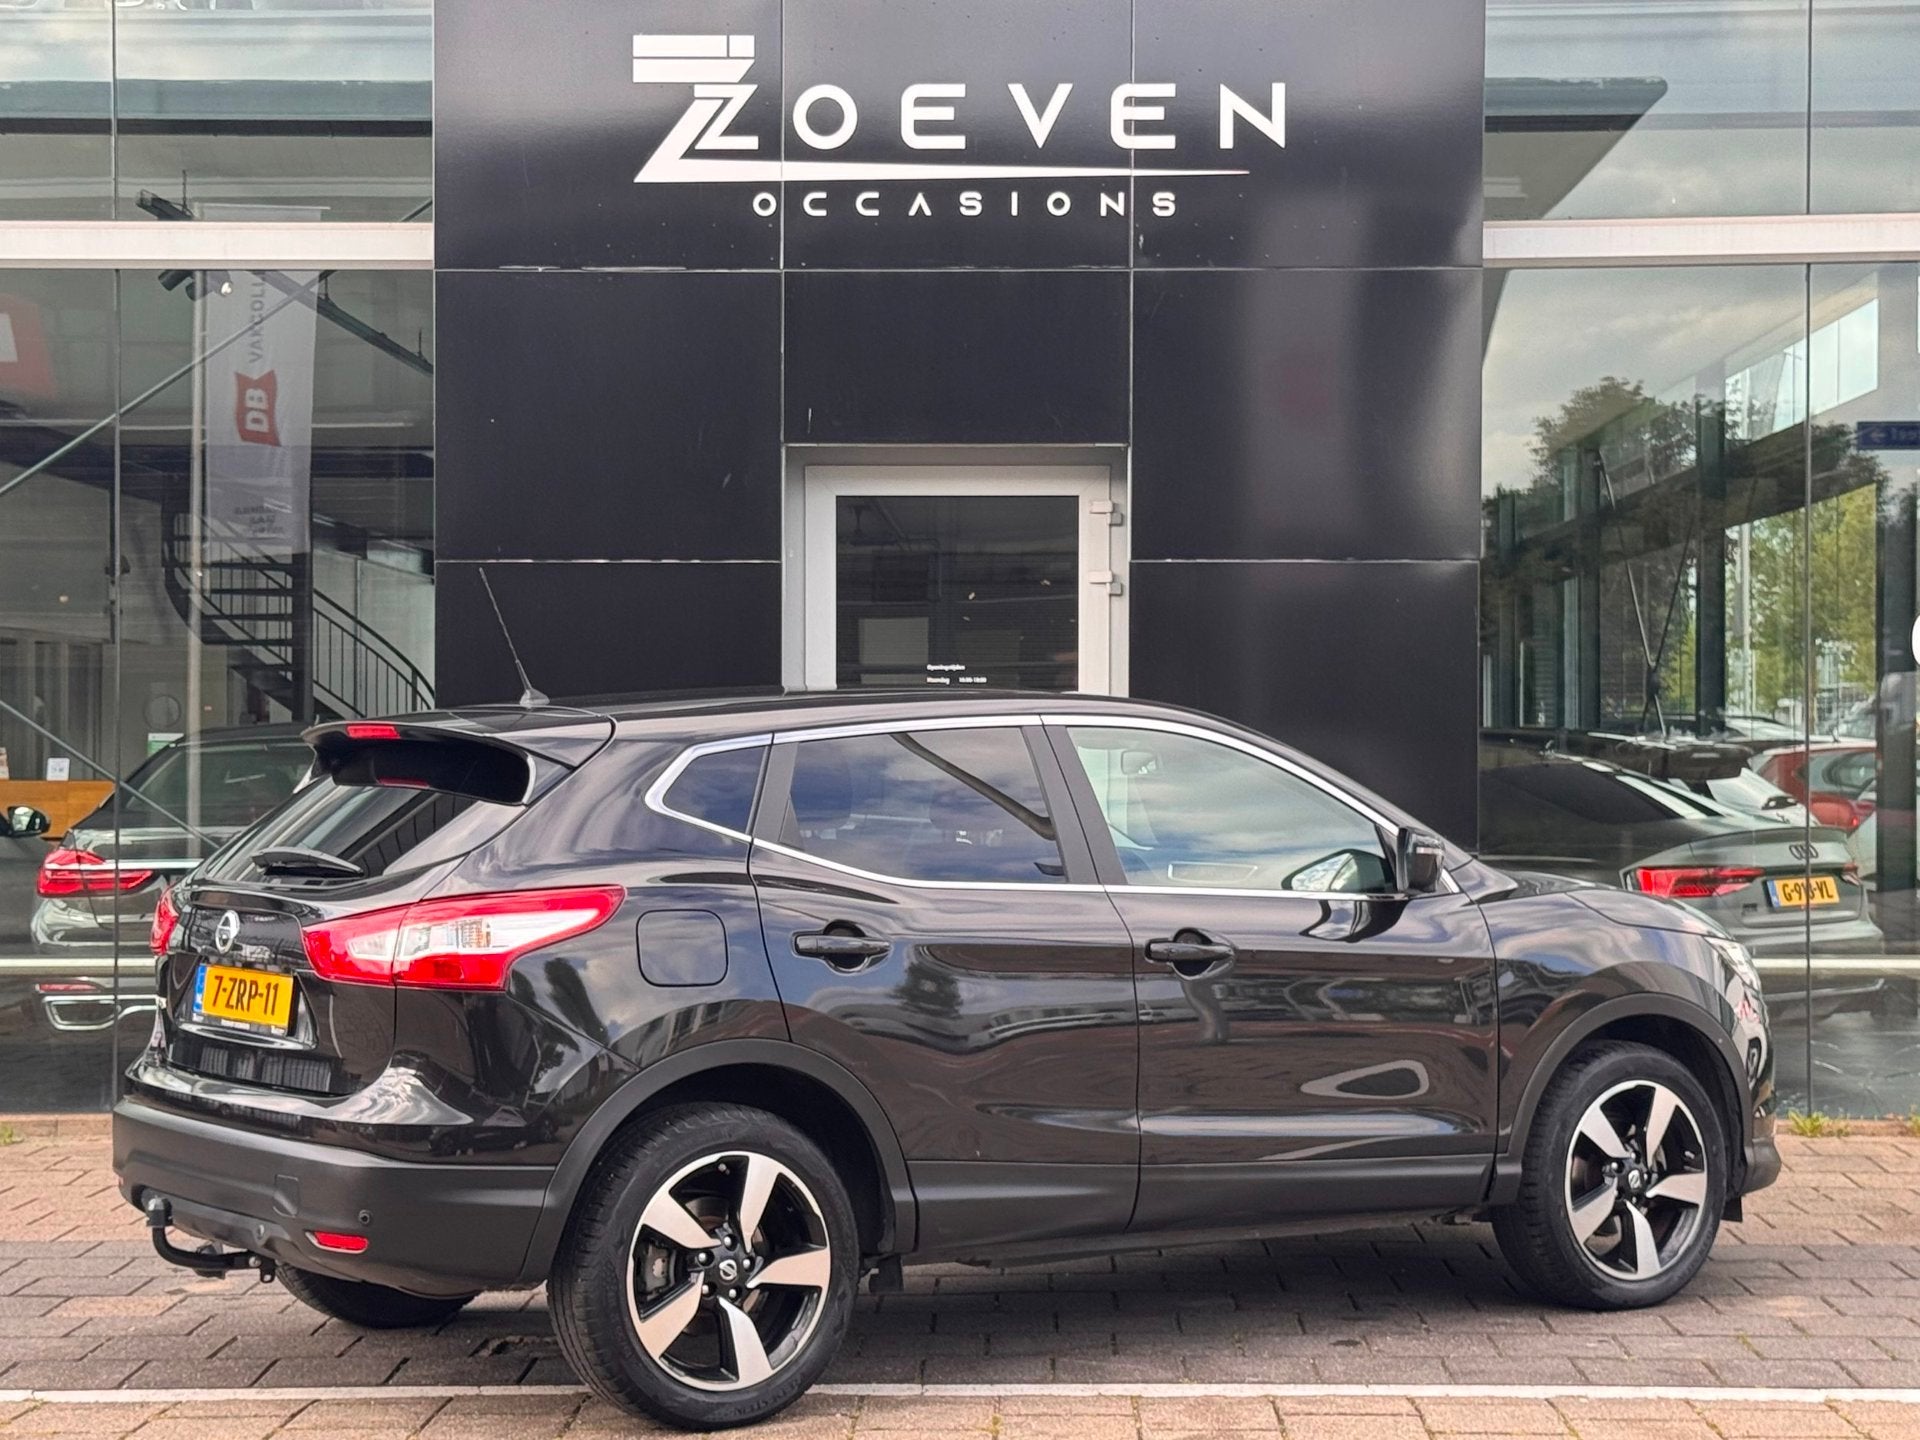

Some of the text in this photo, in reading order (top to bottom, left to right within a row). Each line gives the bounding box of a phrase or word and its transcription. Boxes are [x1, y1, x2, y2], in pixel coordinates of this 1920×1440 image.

[633, 35, 1286, 152] ZOEVEN
[753, 191, 1177, 218] OCCASIONS
[245, 388, 270, 433] DB
[212, 975, 279, 1016] 7-ZRP-11
